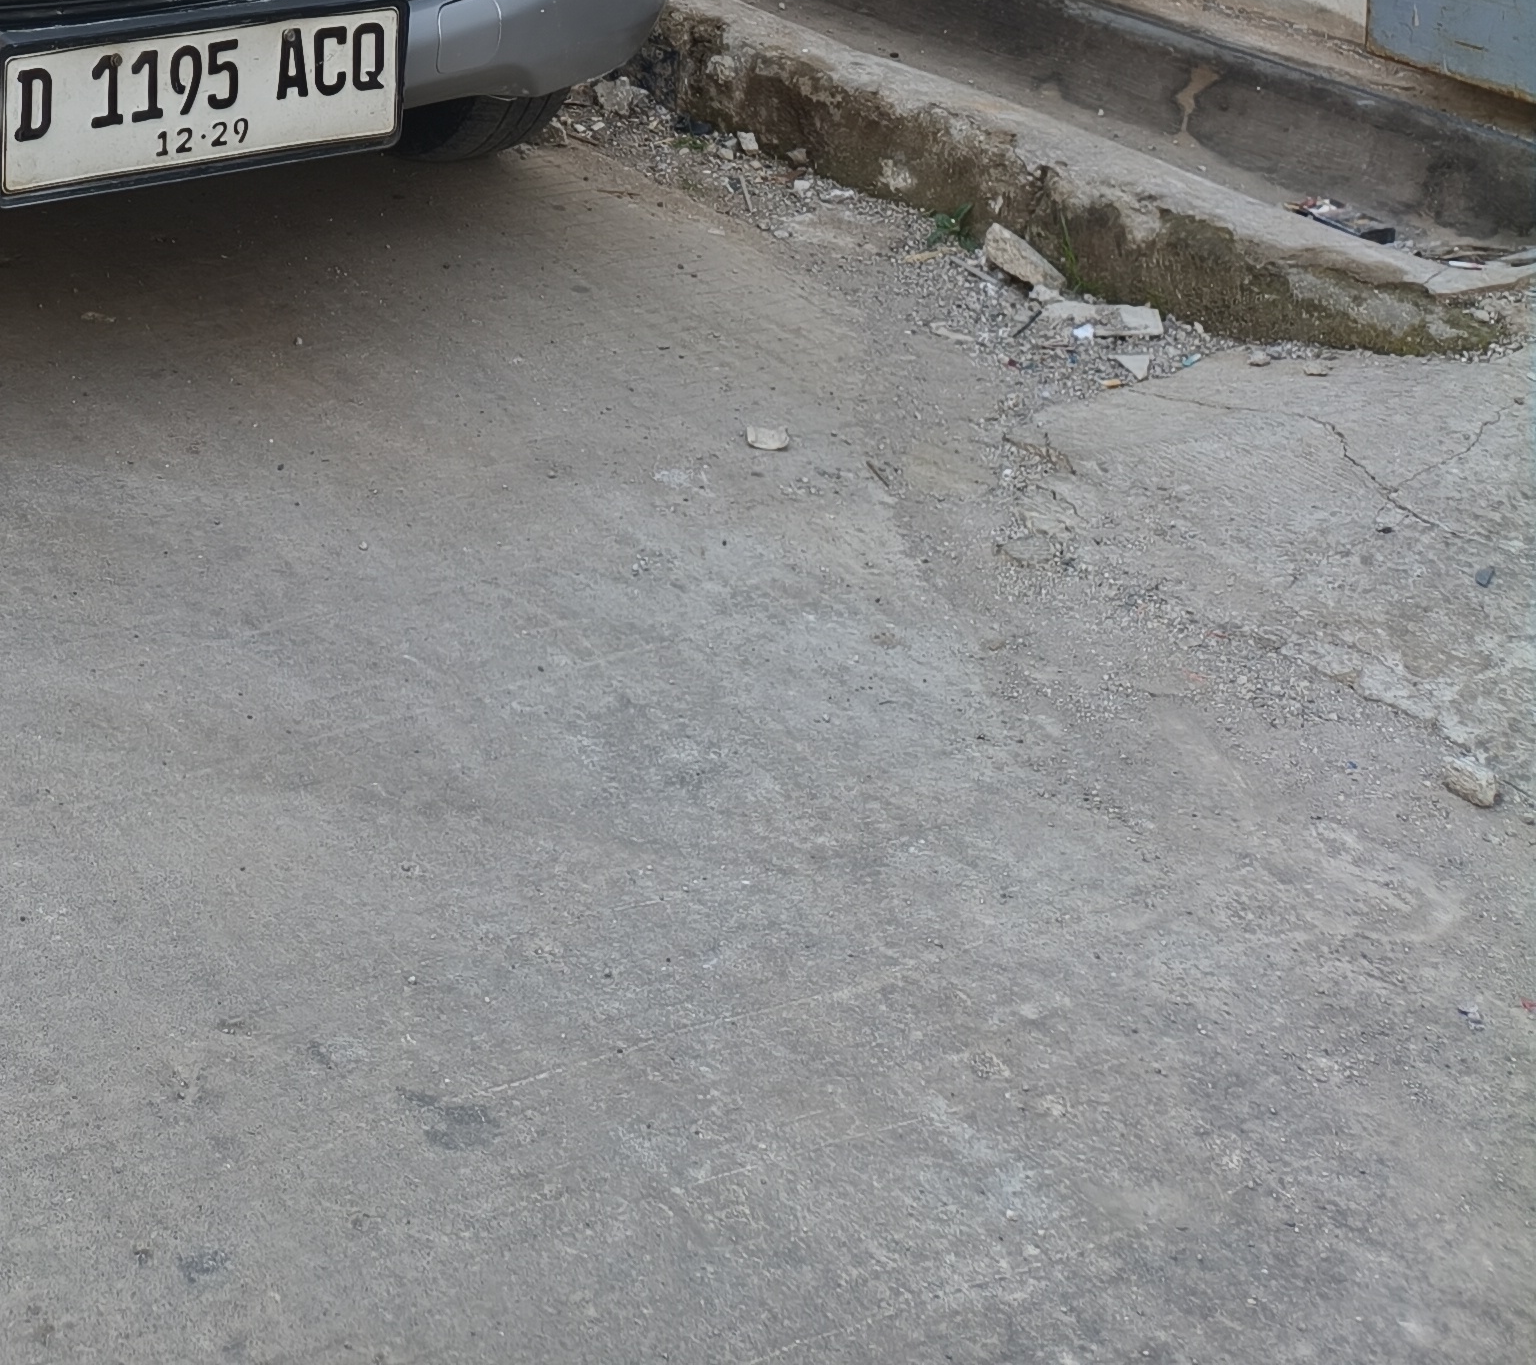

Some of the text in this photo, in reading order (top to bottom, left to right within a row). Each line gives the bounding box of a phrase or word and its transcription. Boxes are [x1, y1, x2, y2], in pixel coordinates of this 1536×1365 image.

[13, 22, 385, 143] D 1195 ACQ
